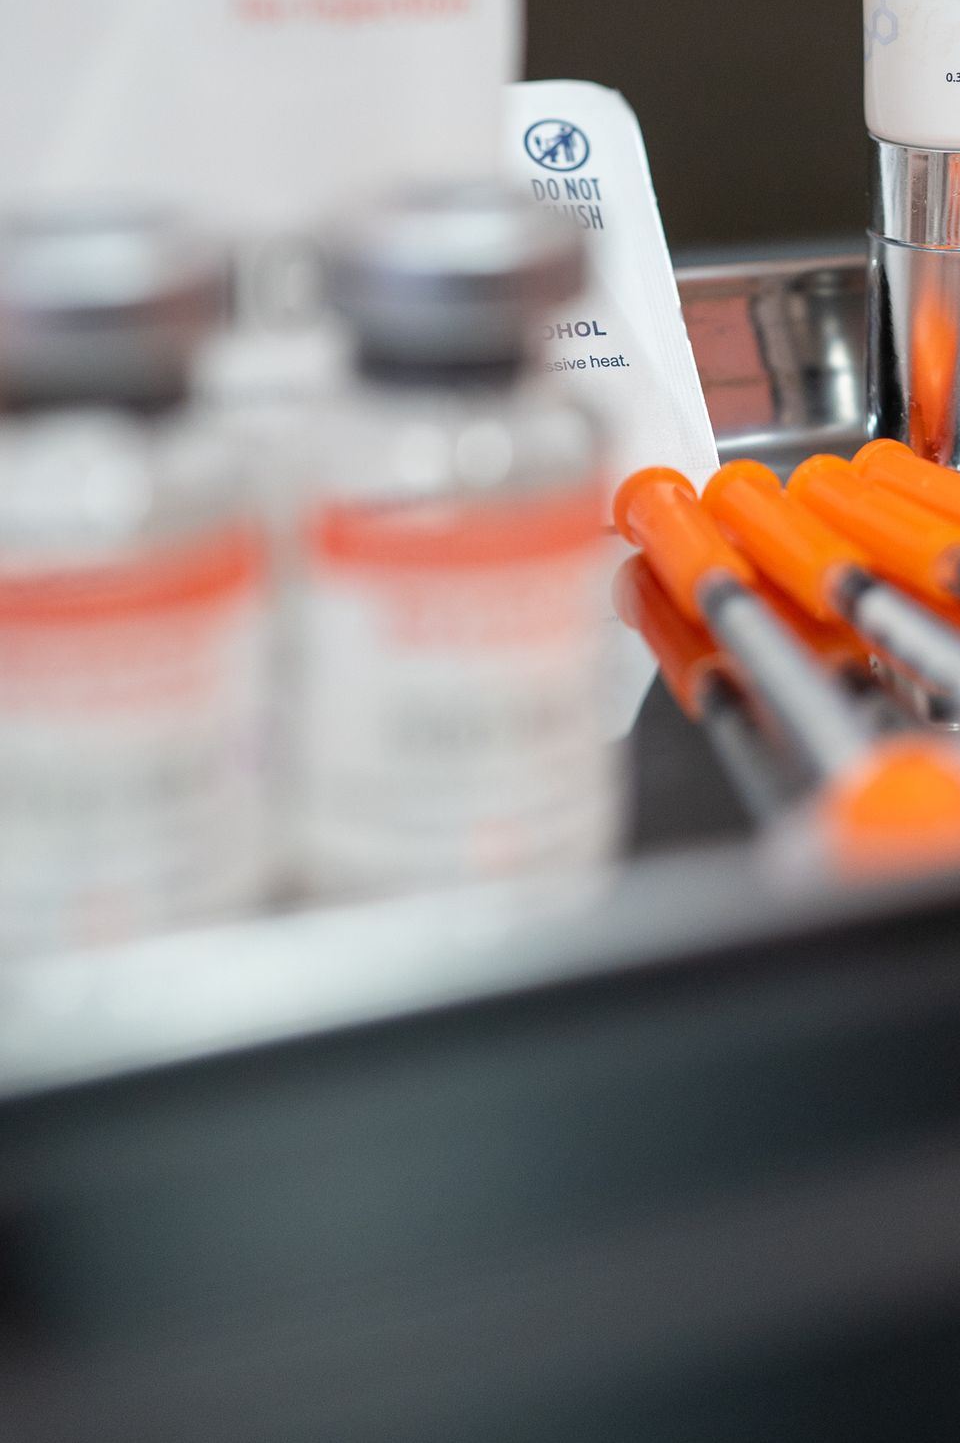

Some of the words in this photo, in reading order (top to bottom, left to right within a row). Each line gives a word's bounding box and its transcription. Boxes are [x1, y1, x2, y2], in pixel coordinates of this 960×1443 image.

[531, 178, 561, 202] DO
[563, 178, 602, 202] NOT
[589, 354, 630, 369] heat.
